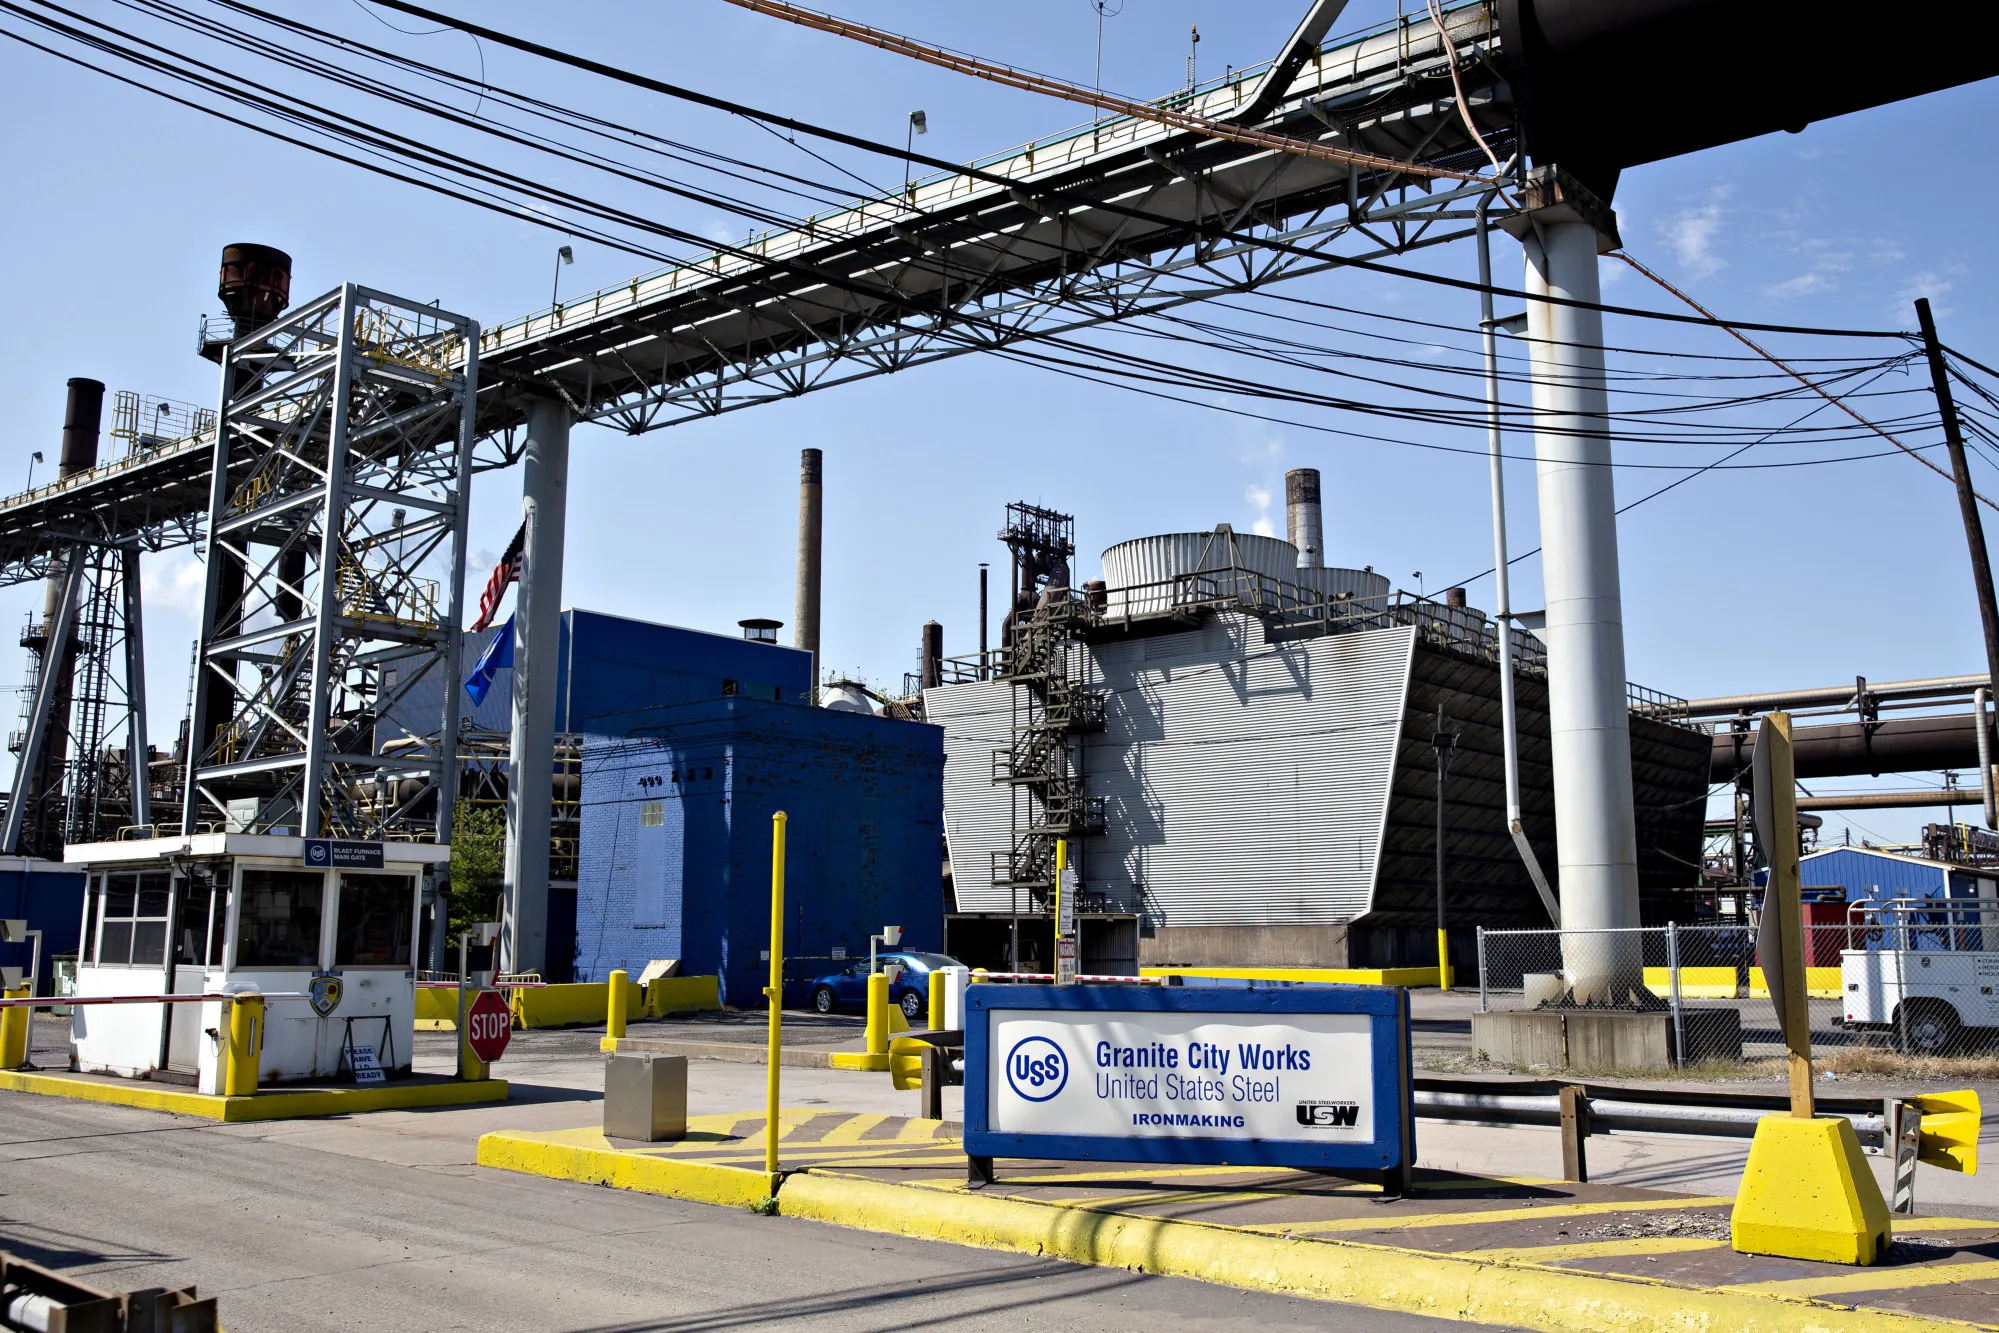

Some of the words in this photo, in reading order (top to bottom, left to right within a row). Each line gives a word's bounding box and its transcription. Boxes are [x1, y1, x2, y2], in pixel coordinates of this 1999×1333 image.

[312, 849, 324, 858] USS
[471, 1012, 508, 1041] STOP
[1016, 1053, 1060, 1087] USS
[1096, 1040, 1179, 1069] Granite
[1188, 1042, 1231, 1076] City
[1238, 1043, 1311, 1071] Works
[356, 1071, 381, 1080] READY
[1096, 1072, 1158, 1100] United
[1166, 1073, 1225, 1102] States
[1232, 1074, 1280, 1103] Steel
[1132, 1113, 1245, 1128] IRONMAKING
[1296, 1104, 1359, 1127] USW
